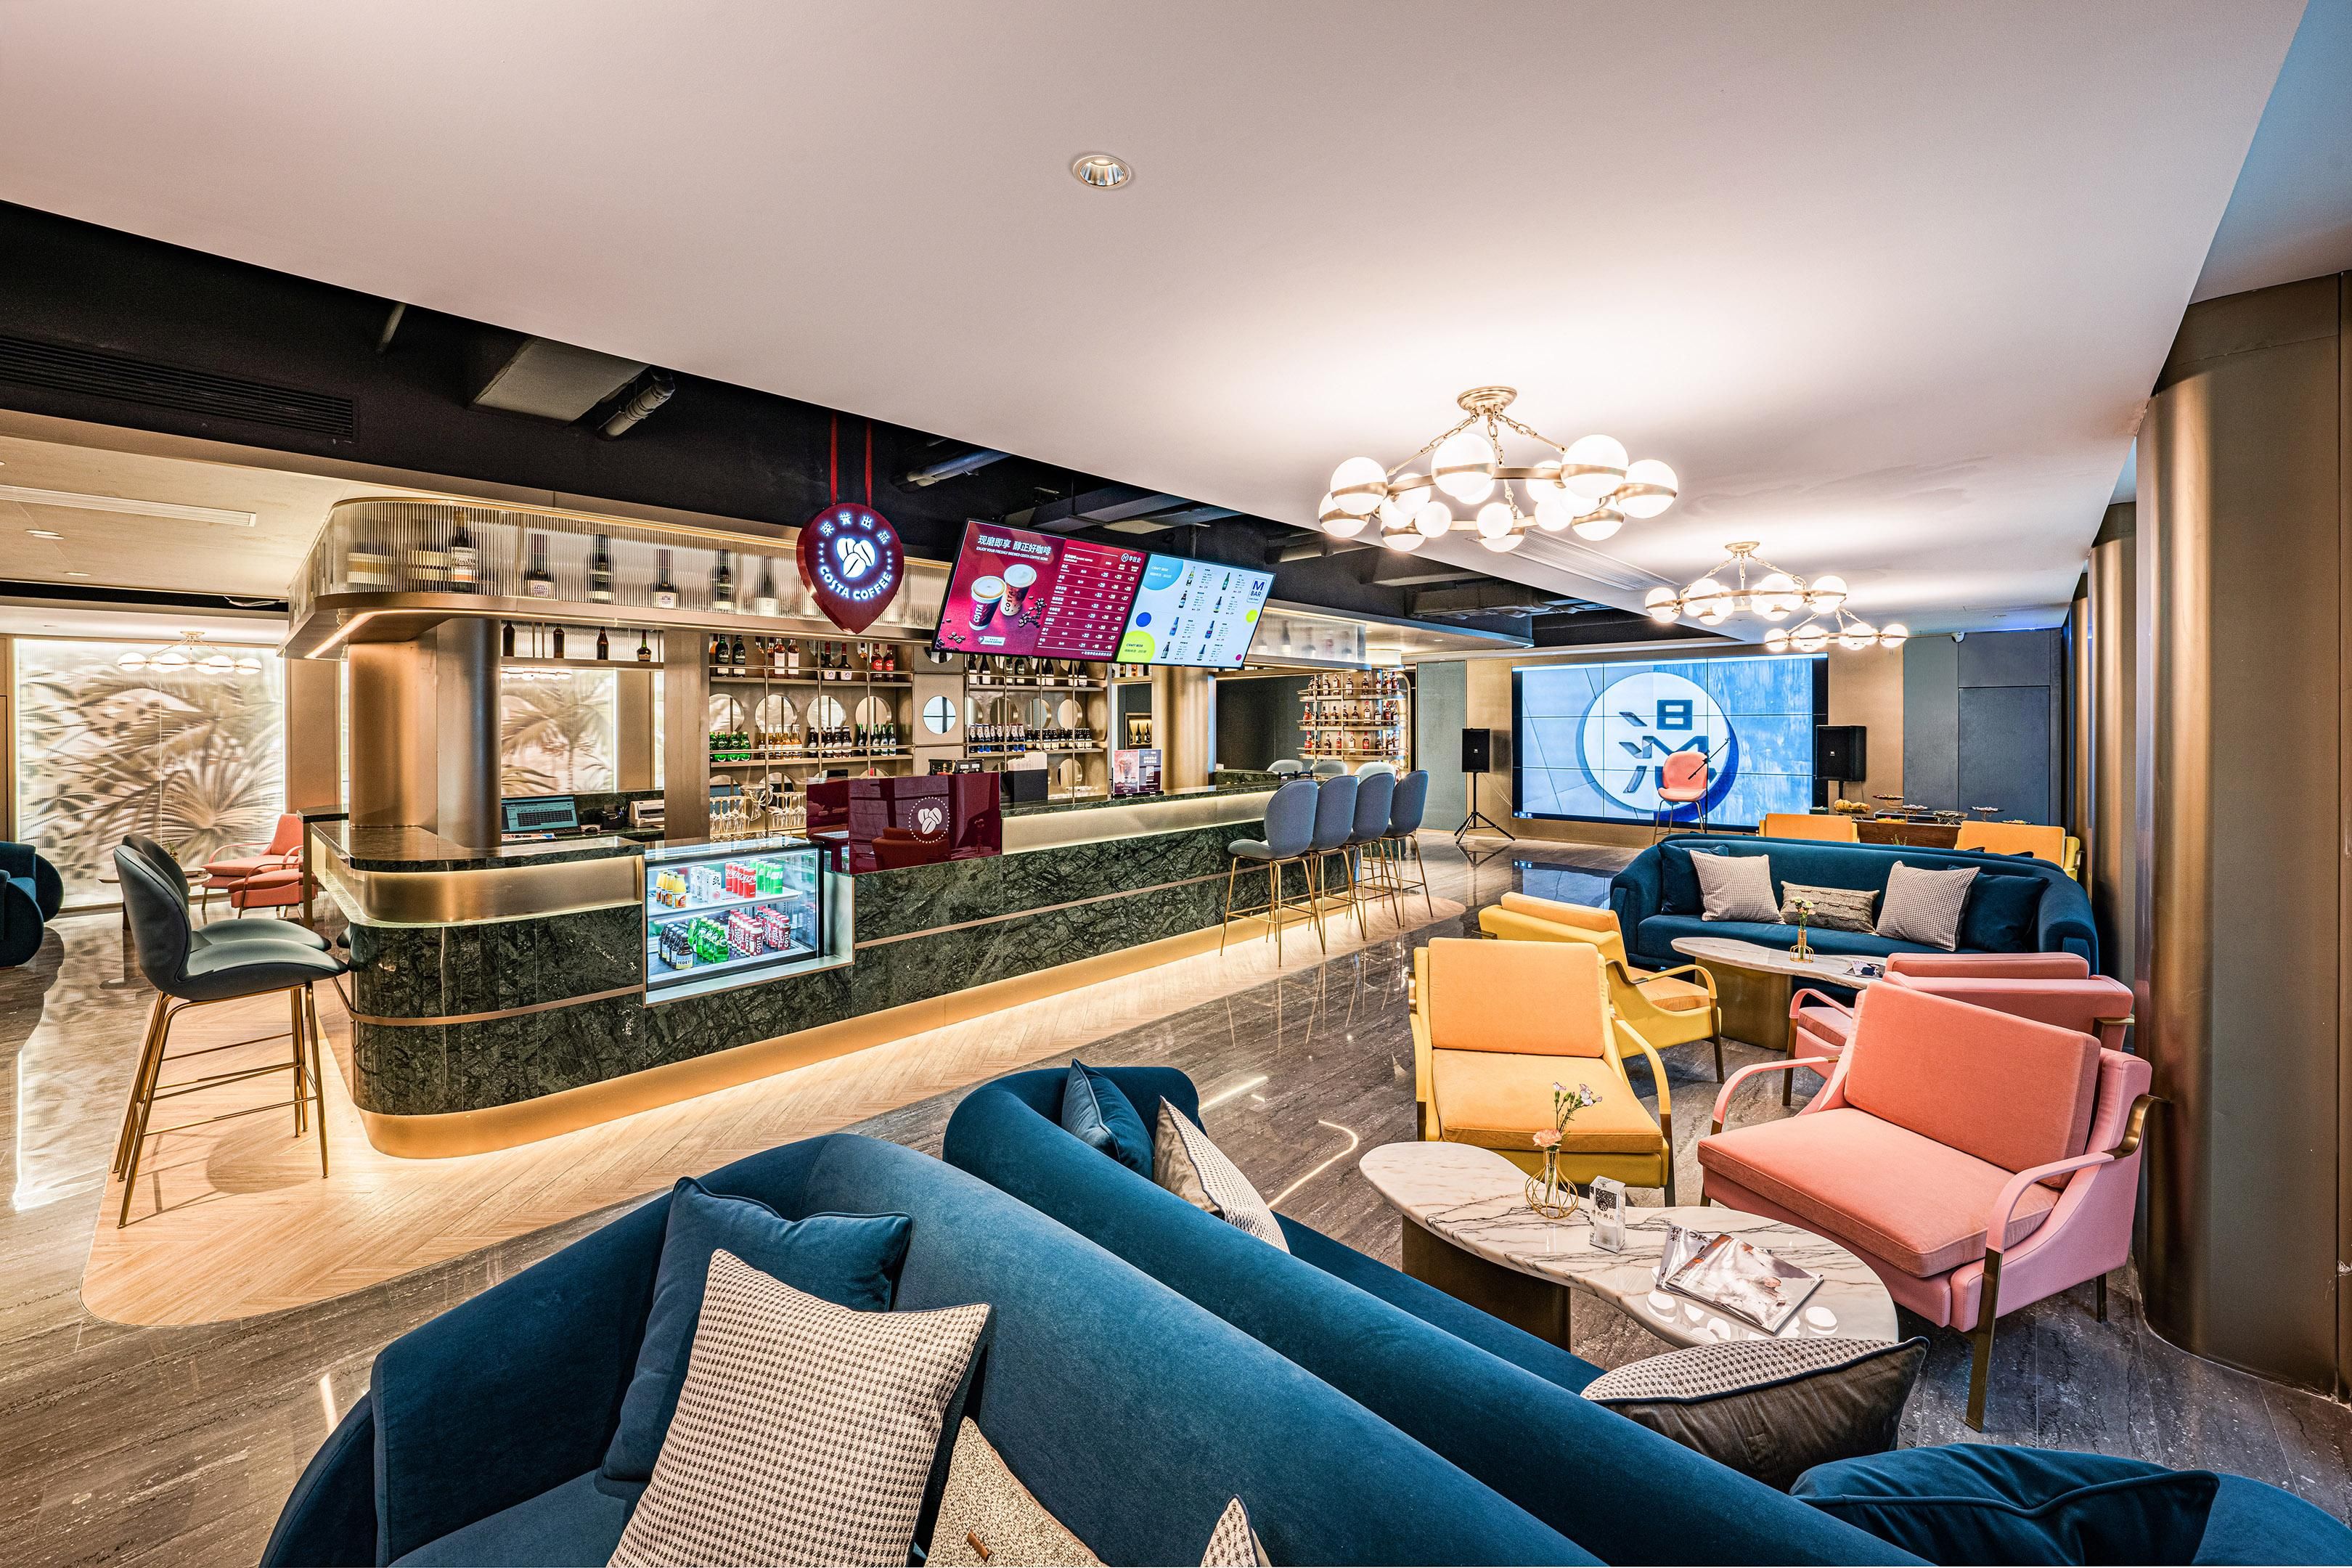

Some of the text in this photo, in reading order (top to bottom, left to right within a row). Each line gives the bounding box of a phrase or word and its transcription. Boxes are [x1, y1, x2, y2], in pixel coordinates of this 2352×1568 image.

[977, 535, 1051, 555] 现磨即享 醇正好咖啡
[820, 566, 892, 600] COSTA COFFEE
[1252, 581, 1265, 591] M
[1005, 589, 1015, 611] COSTA
[973, 604, 984, 623] COSTA
